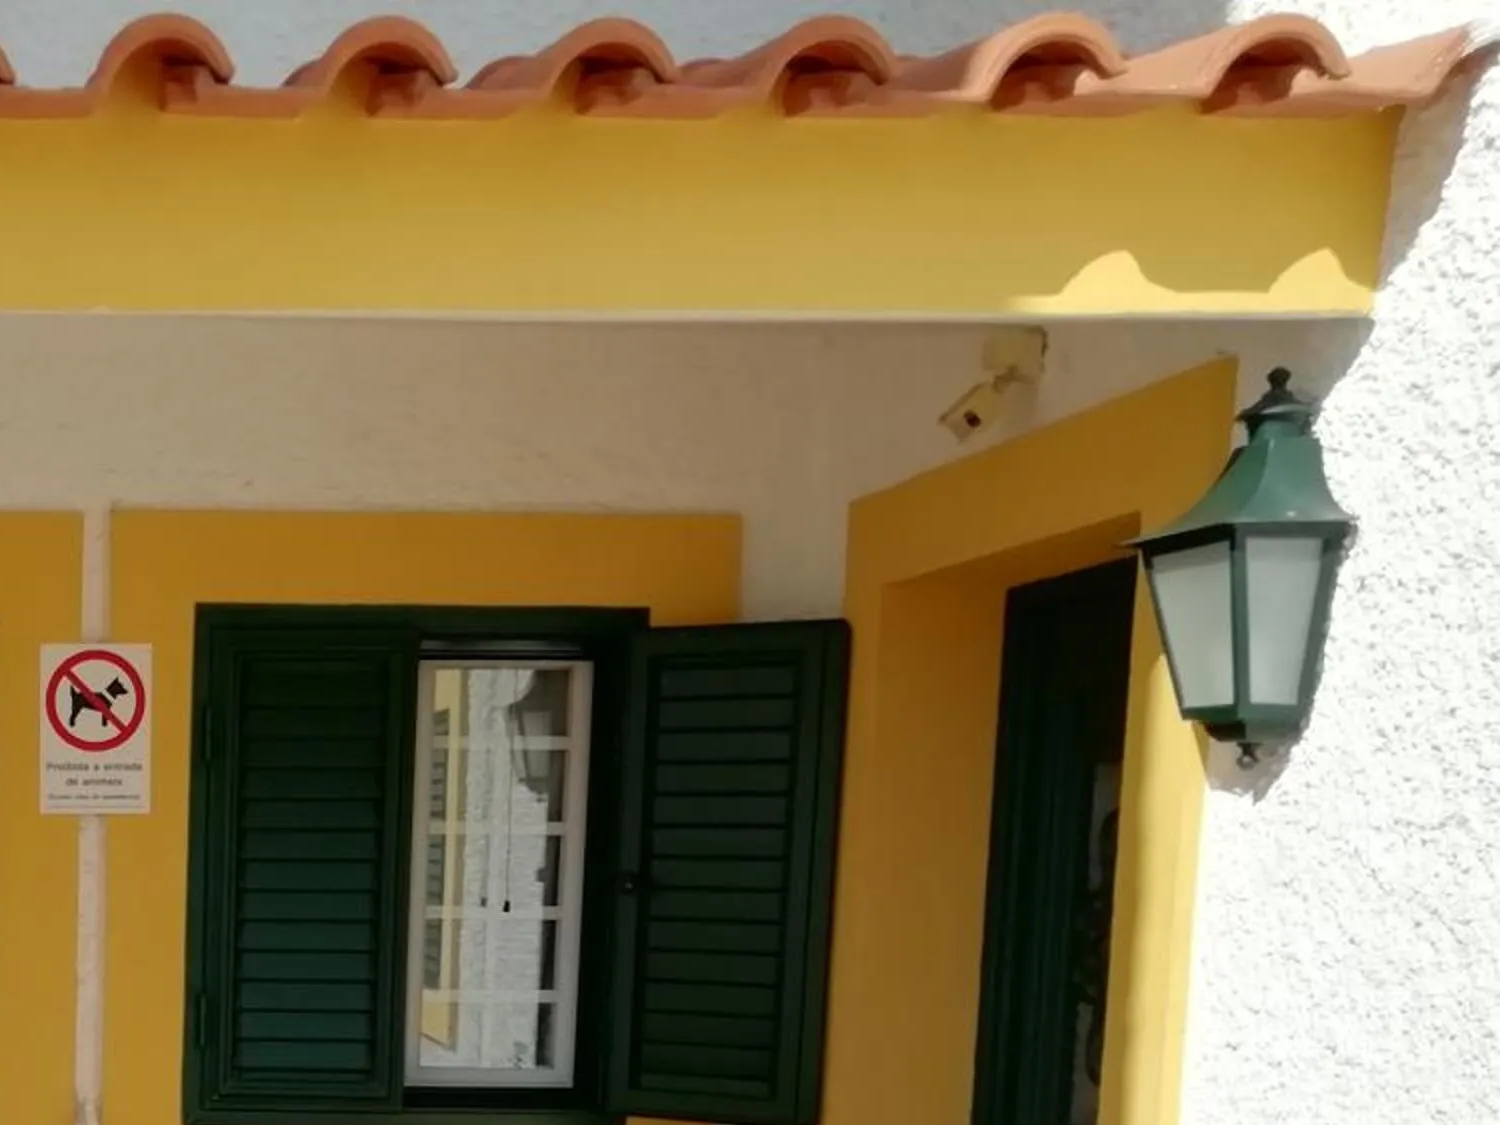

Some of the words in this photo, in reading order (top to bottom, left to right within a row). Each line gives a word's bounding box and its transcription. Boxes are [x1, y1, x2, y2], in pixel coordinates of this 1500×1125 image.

[46, 761, 89, 772] Proibida
[103, 761, 142, 772] entrada
[65, 777, 79, 787] de
[82, 777, 123, 787] animais
